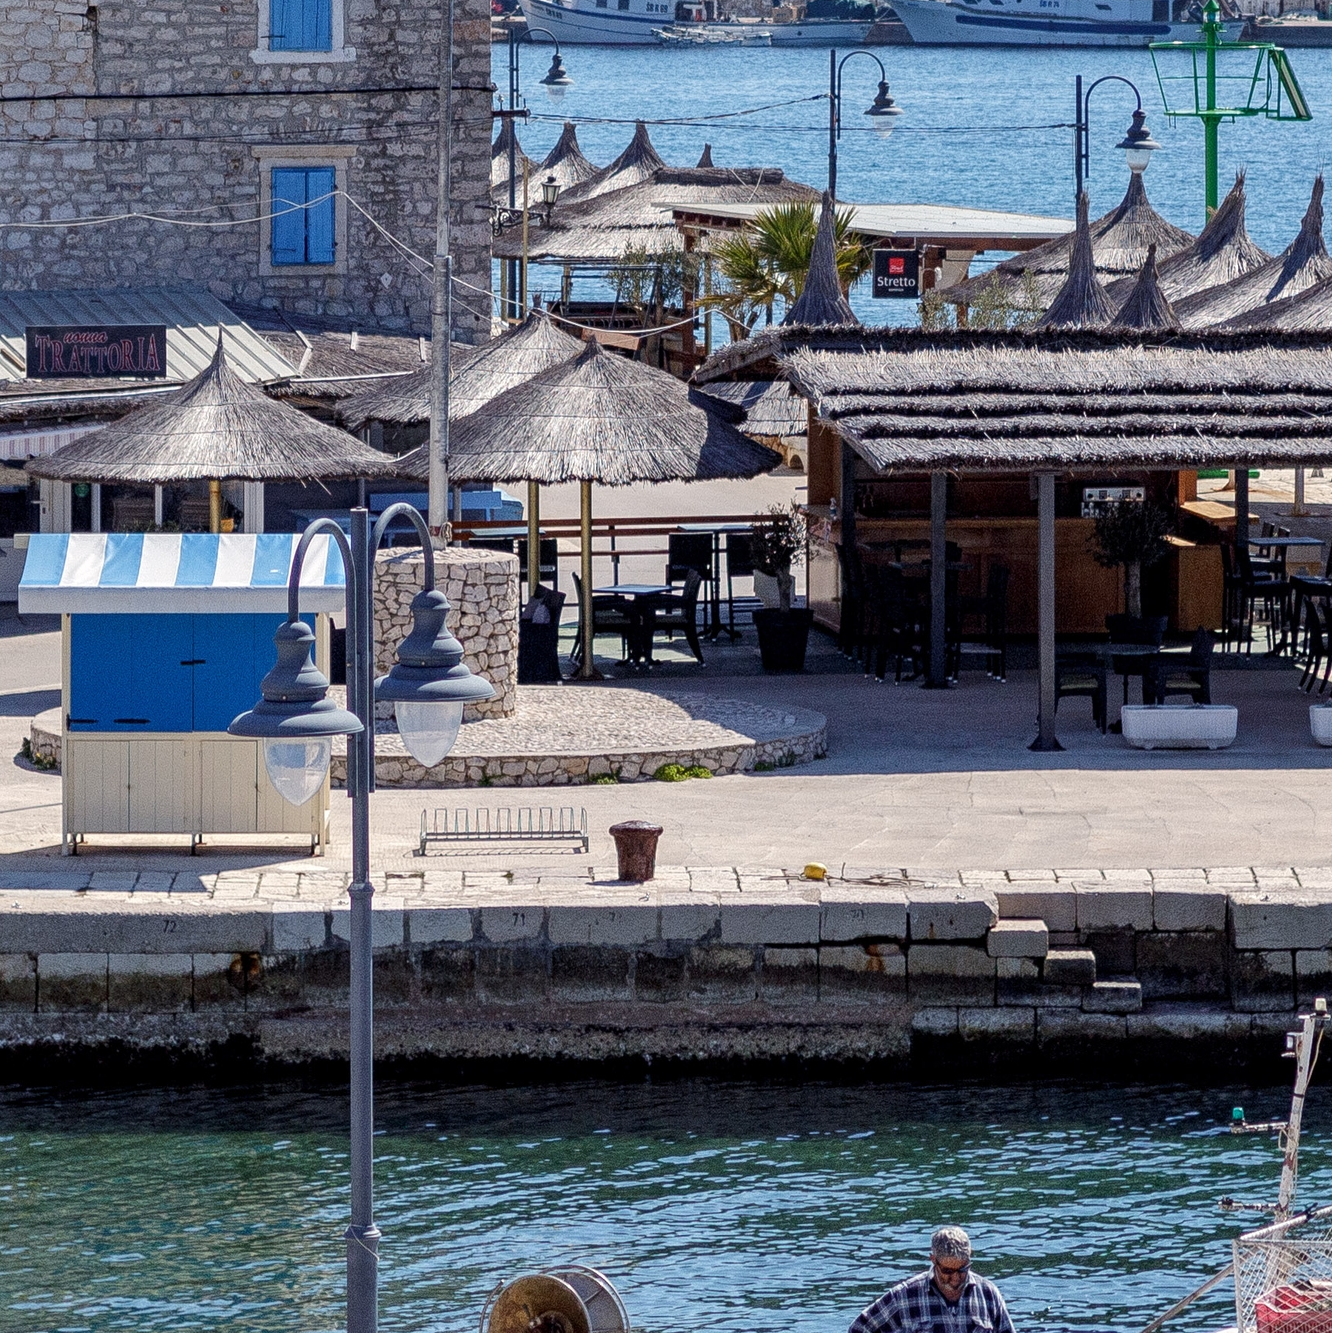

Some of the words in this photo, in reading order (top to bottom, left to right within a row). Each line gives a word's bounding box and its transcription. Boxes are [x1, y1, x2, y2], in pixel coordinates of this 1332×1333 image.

[877, 276, 916, 287] Stretto
[34, 333, 160, 373] TRATTORIA
[512, 912, 525, 926] 71
[163, 919, 176, 934] 72
